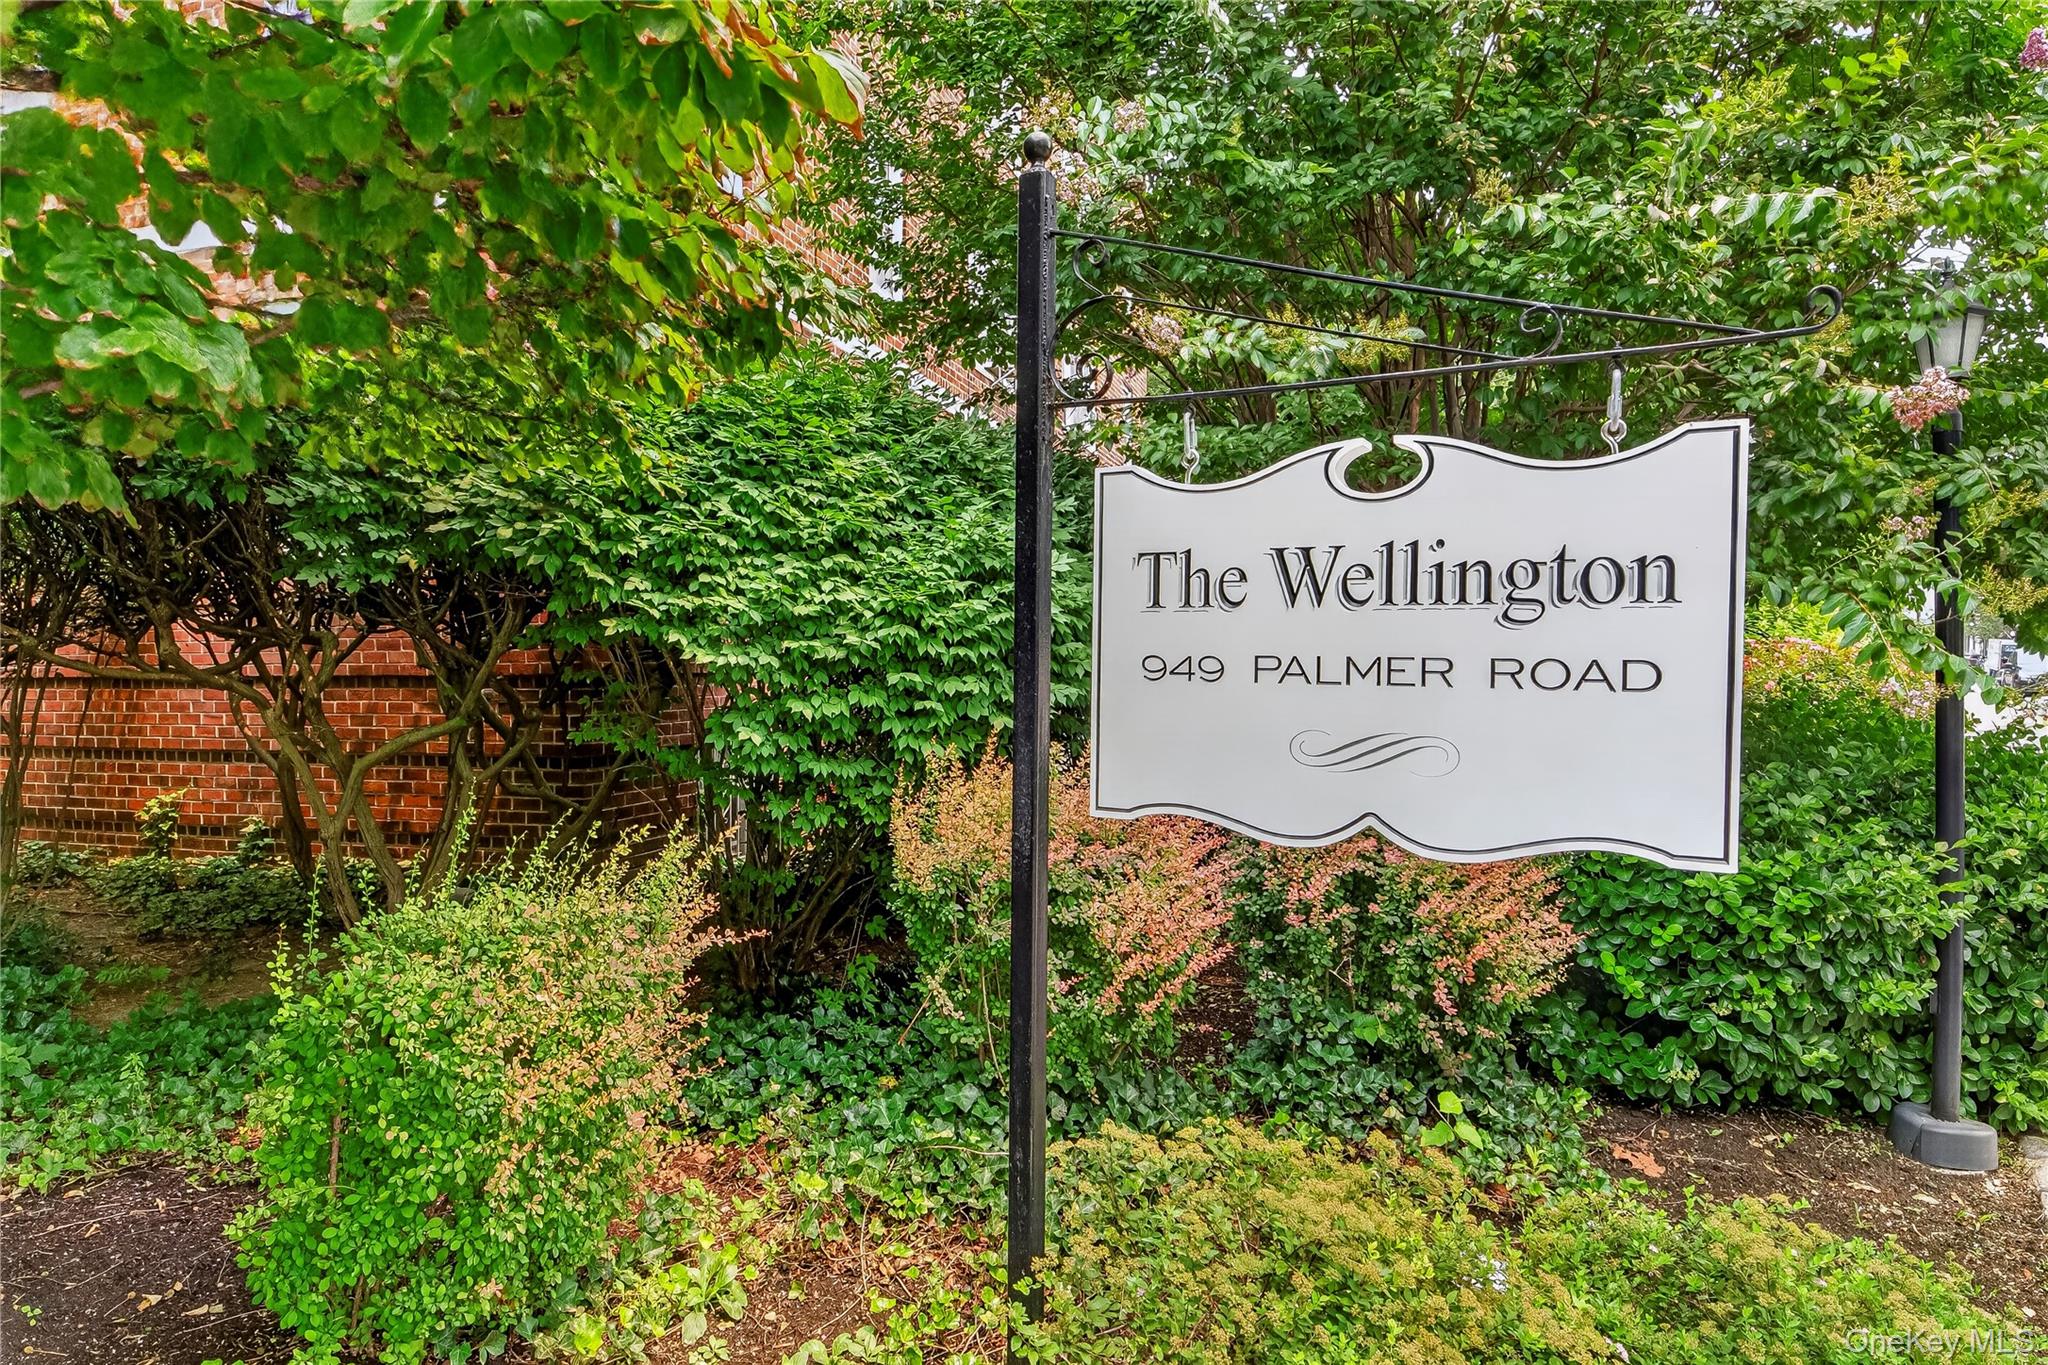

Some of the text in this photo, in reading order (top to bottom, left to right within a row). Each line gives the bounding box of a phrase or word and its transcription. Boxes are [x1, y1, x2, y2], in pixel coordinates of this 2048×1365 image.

[1133, 538, 1683, 631] The Wellington
[1141, 654, 1663, 693] 949 PALMER ROAD
